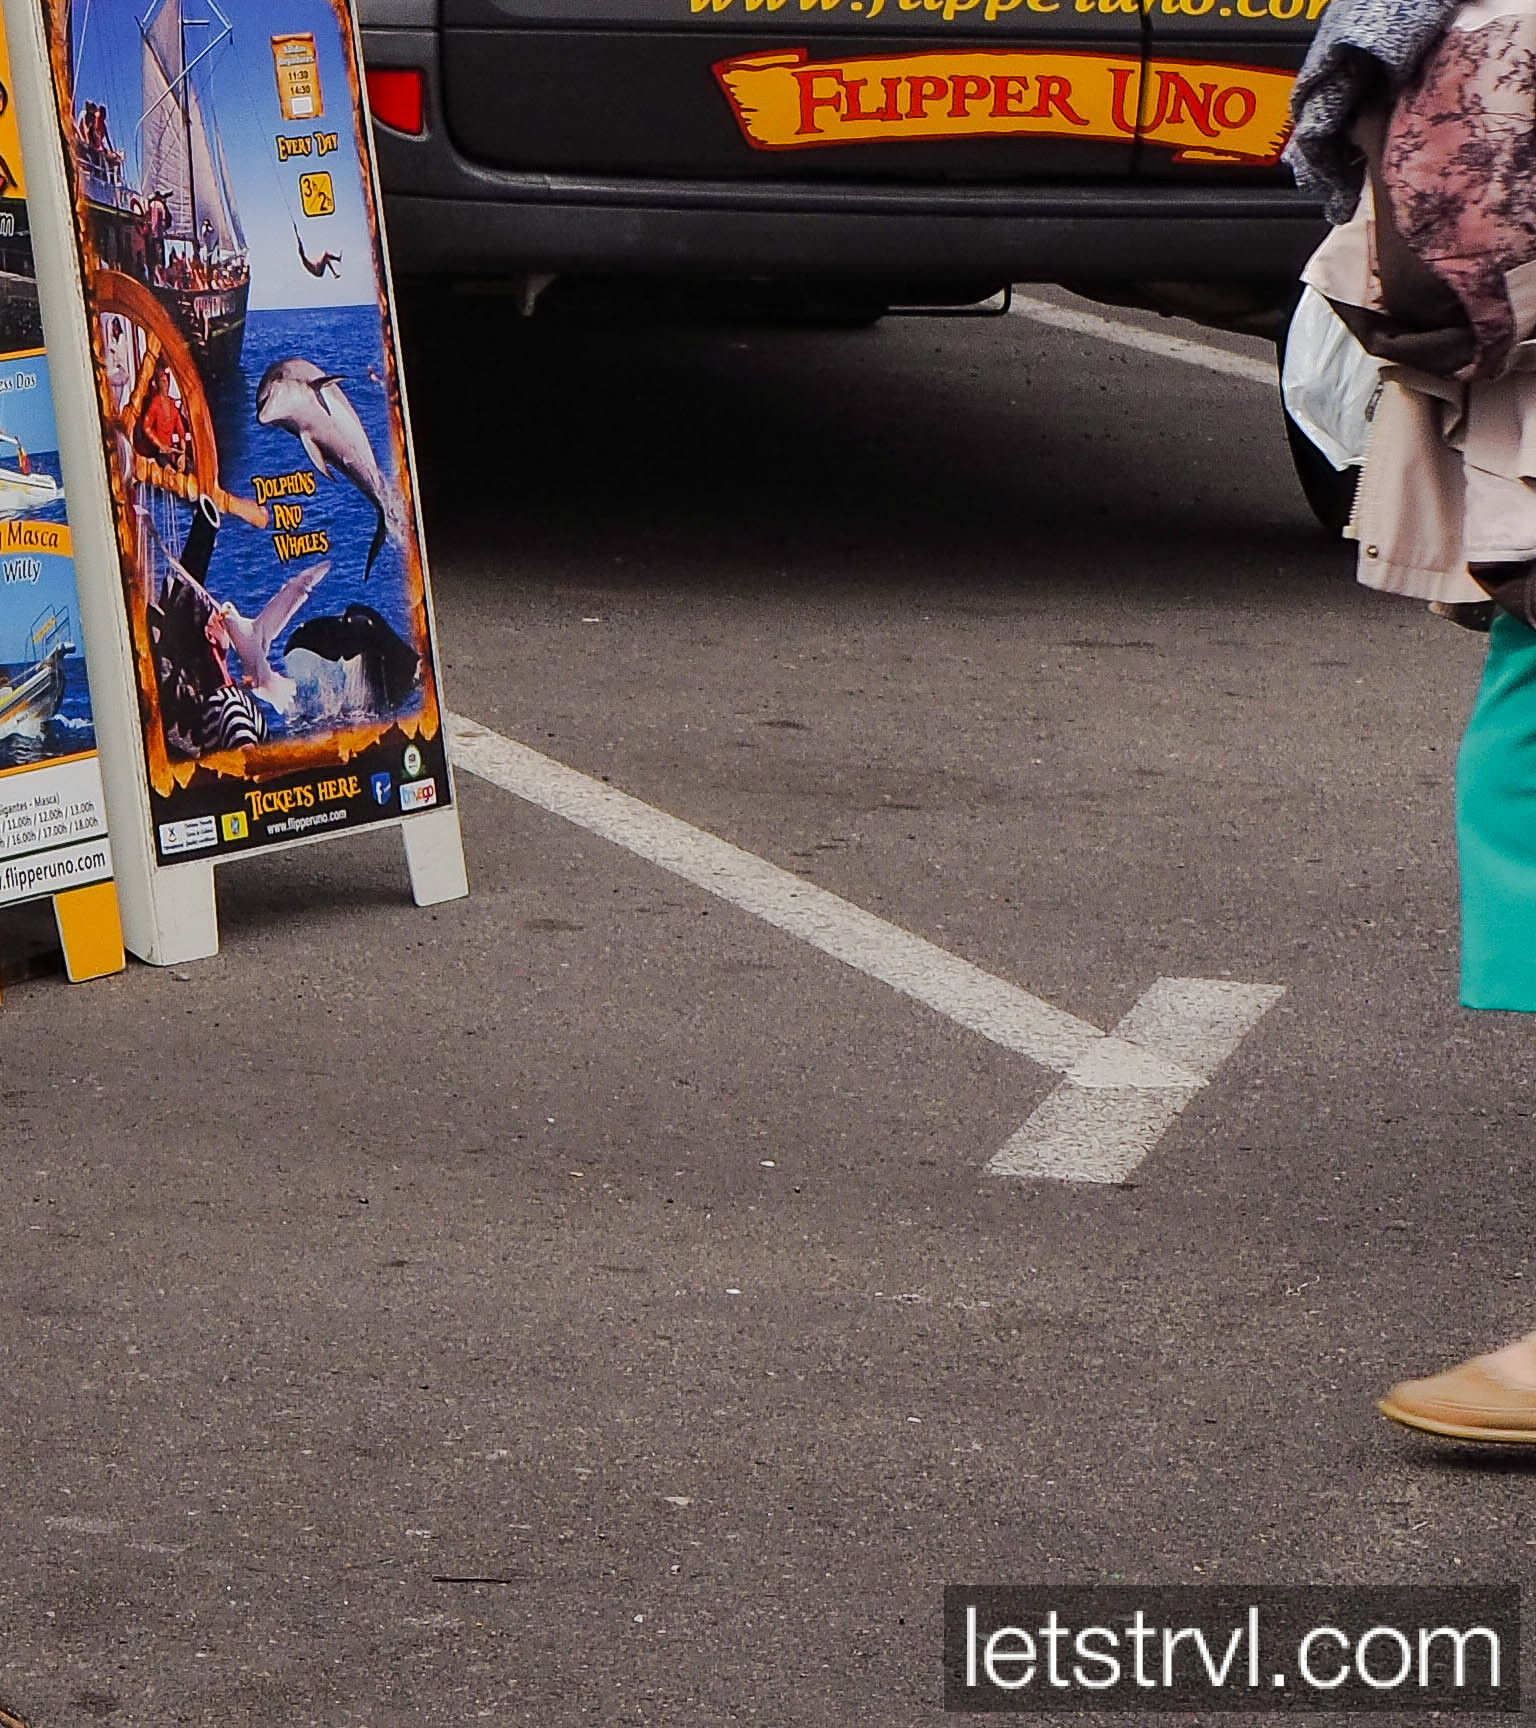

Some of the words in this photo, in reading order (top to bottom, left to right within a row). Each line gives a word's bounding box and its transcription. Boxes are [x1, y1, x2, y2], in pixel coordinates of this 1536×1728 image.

[795, 68, 1091, 137] FLIPPER
[1109, 67, 1261, 139] UNO
[277, 135, 313, 163] EVERY
[251, 470, 318, 506] DOLPHINS
[273, 503, 304, 532] AND
[6, 520, 60, 549] Masca
[272, 530, 330, 563] WHALES
[3, 557, 42, 583] Willy
[244, 783, 315, 821] TICKETS
[318, 775, 363, 802] HERE
